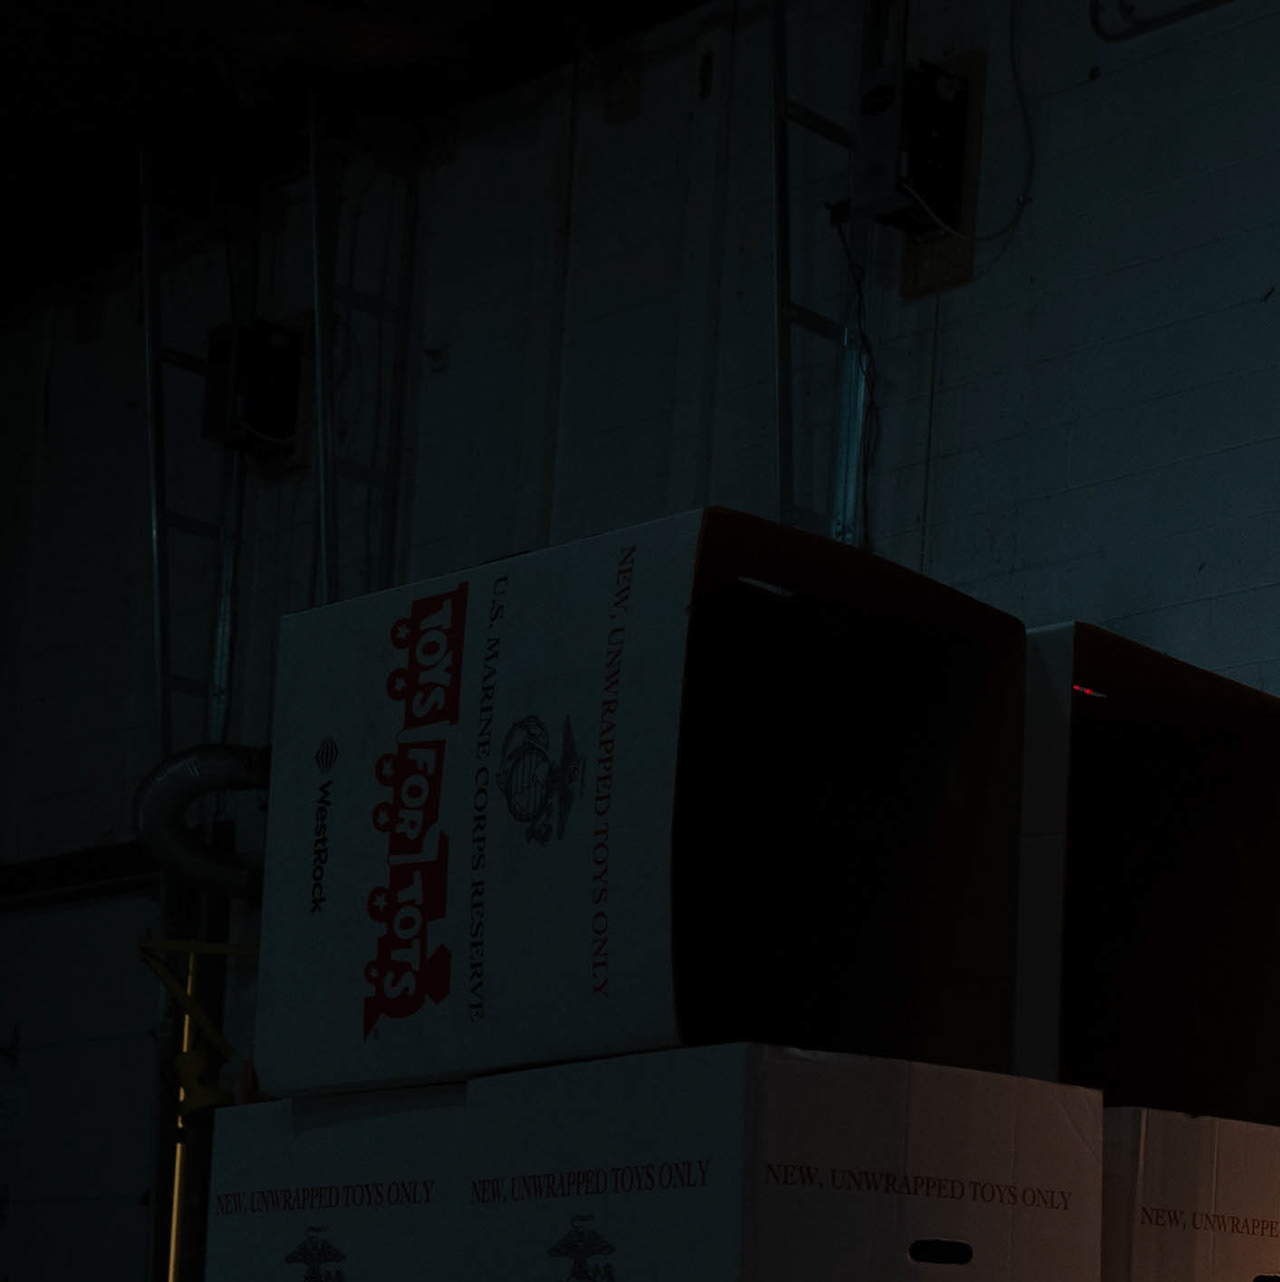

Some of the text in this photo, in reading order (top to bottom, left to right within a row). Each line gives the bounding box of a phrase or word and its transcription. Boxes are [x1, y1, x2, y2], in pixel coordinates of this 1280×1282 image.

[385, 600, 452, 1000] TOYS FOR TOTS
[469, 575, 508, 1021] U.S. MARINE CORPS RESERVE
[592, 545, 637, 997] NEW, UNWRAPPED TOYS ONLY
[311, 780, 332, 913] WestRock
[216, 1180, 435, 1215] NEW, UNWRAPPED TOYS ONLY
[471, 1159, 710, 1204] NEW, UNWRAPPED TOYS ONLY
[765, 1164, 1073, 1210] NEW, UNWRAPPED TOYS ONLY
[1140, 1207, 1186, 1232] NEW,
